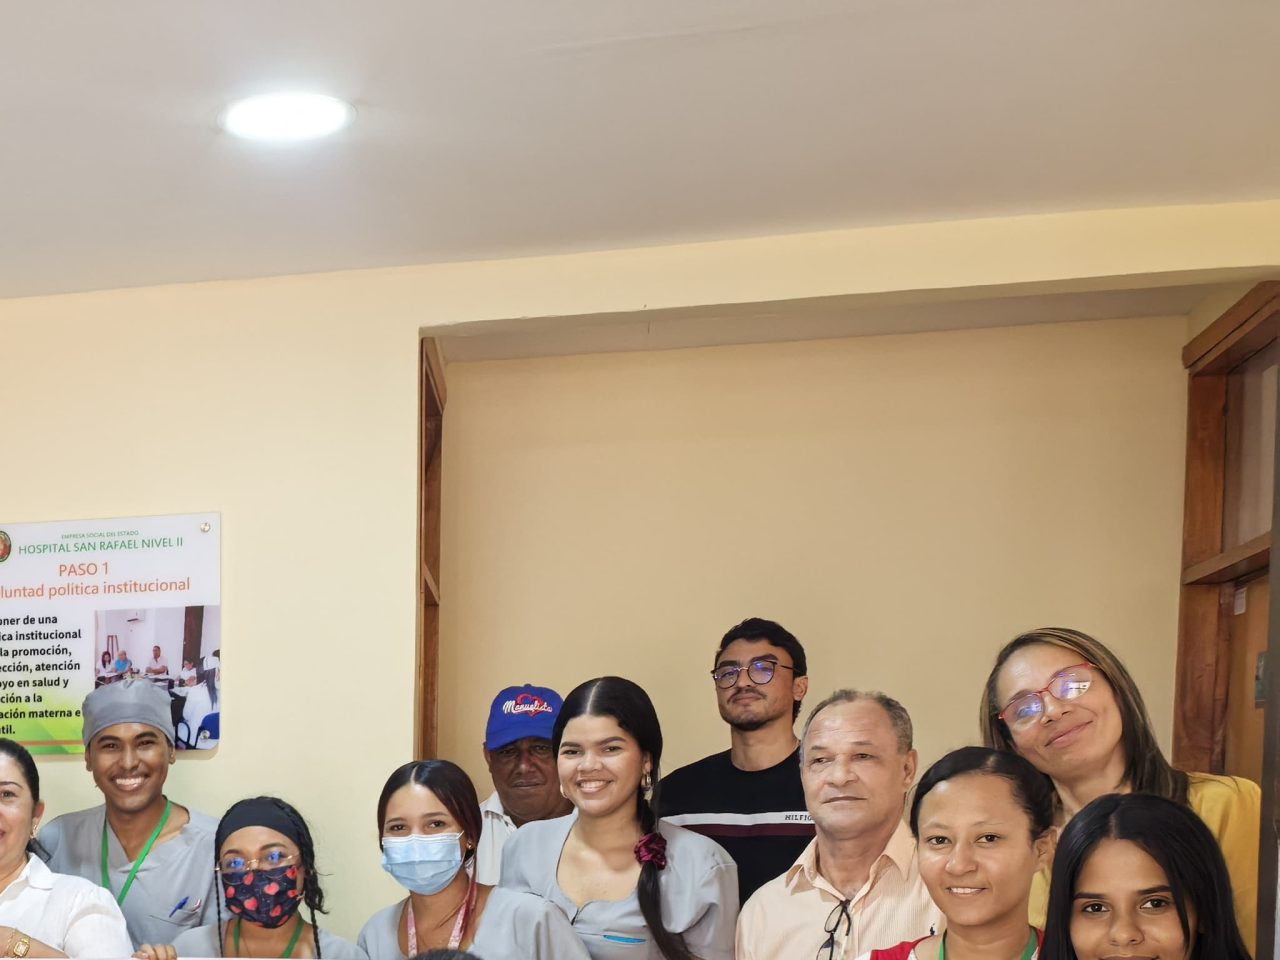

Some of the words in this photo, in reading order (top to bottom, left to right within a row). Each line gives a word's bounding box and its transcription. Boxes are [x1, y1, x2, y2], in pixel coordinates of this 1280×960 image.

[18, 543, 70, 555] HOSPITAL
[74, 542, 96, 552] SAN
[100, 539, 138, 550] RAFAEL
[142, 538, 173, 548] NIVEL
[176, 537, 183, 546] II
[59, 562, 98, 576] PASO
[102, 562, 109, 574] 1
[48, 581, 99, 600] política
[103, 577, 190, 595] institucional
[23, 614, 36, 625] de
[38, 615, 58, 624] una
[16, 629, 82, 641] institucional
[0, 646, 9, 656] la
[12, 644, 72, 659] promoción,
[35, 660, 80, 672] atención
[17, 680, 30, 688] en
[32, 678, 60, 688] salud
[63, 678, 69, 688] y
[24, 695, 31, 703] a
[33, 693, 42, 703] la
[28, 709, 72, 718] materna
[74, 709, 81, 718] e
